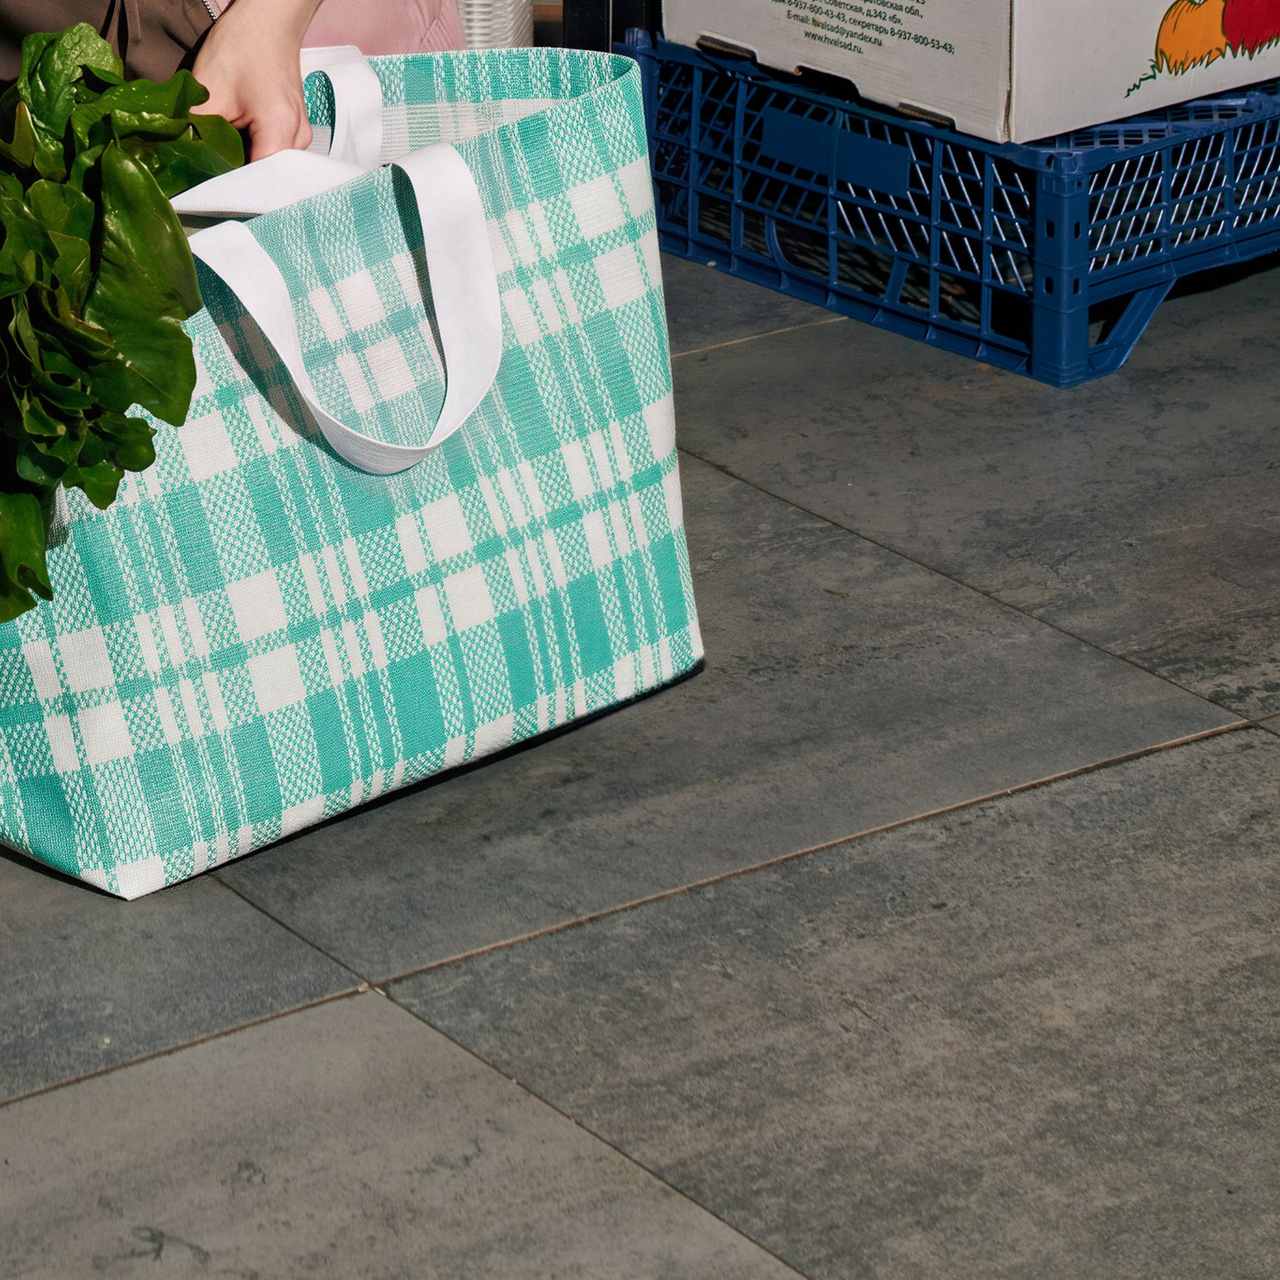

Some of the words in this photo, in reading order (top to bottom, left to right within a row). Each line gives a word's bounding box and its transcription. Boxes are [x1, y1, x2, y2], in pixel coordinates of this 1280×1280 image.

[905, 6, 923, 19] обл.,
[787, 10, 810, 25] E-mail:
[812, 17, 882, 47] hvalsad@yandex.ru
[848, 16, 889, 35] секретарь
